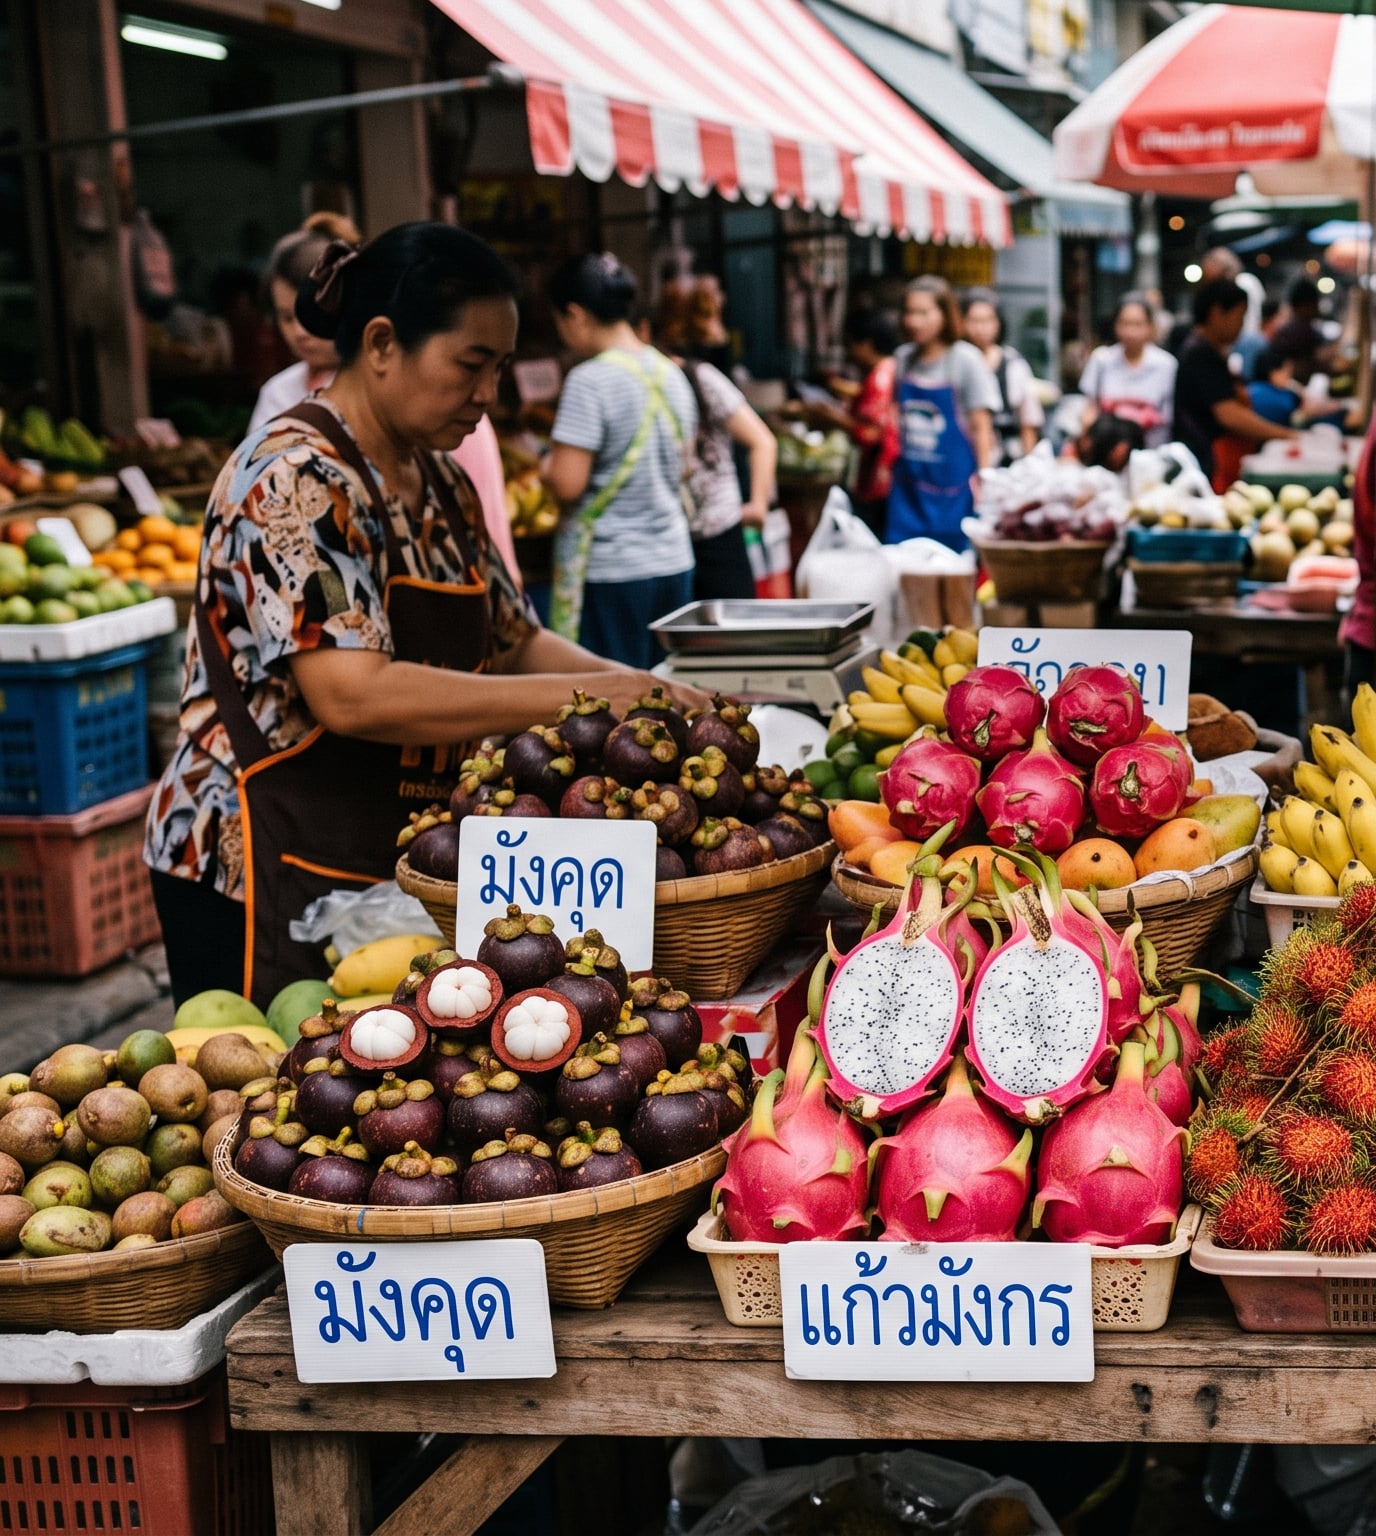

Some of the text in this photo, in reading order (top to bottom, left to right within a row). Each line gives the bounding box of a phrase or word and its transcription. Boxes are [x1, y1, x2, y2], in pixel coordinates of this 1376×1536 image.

[480, 830, 623, 932] มังคุด
[314, 1250, 514, 1373] มังคุด
[800, 1251, 1073, 1346] แก้วมังกร
